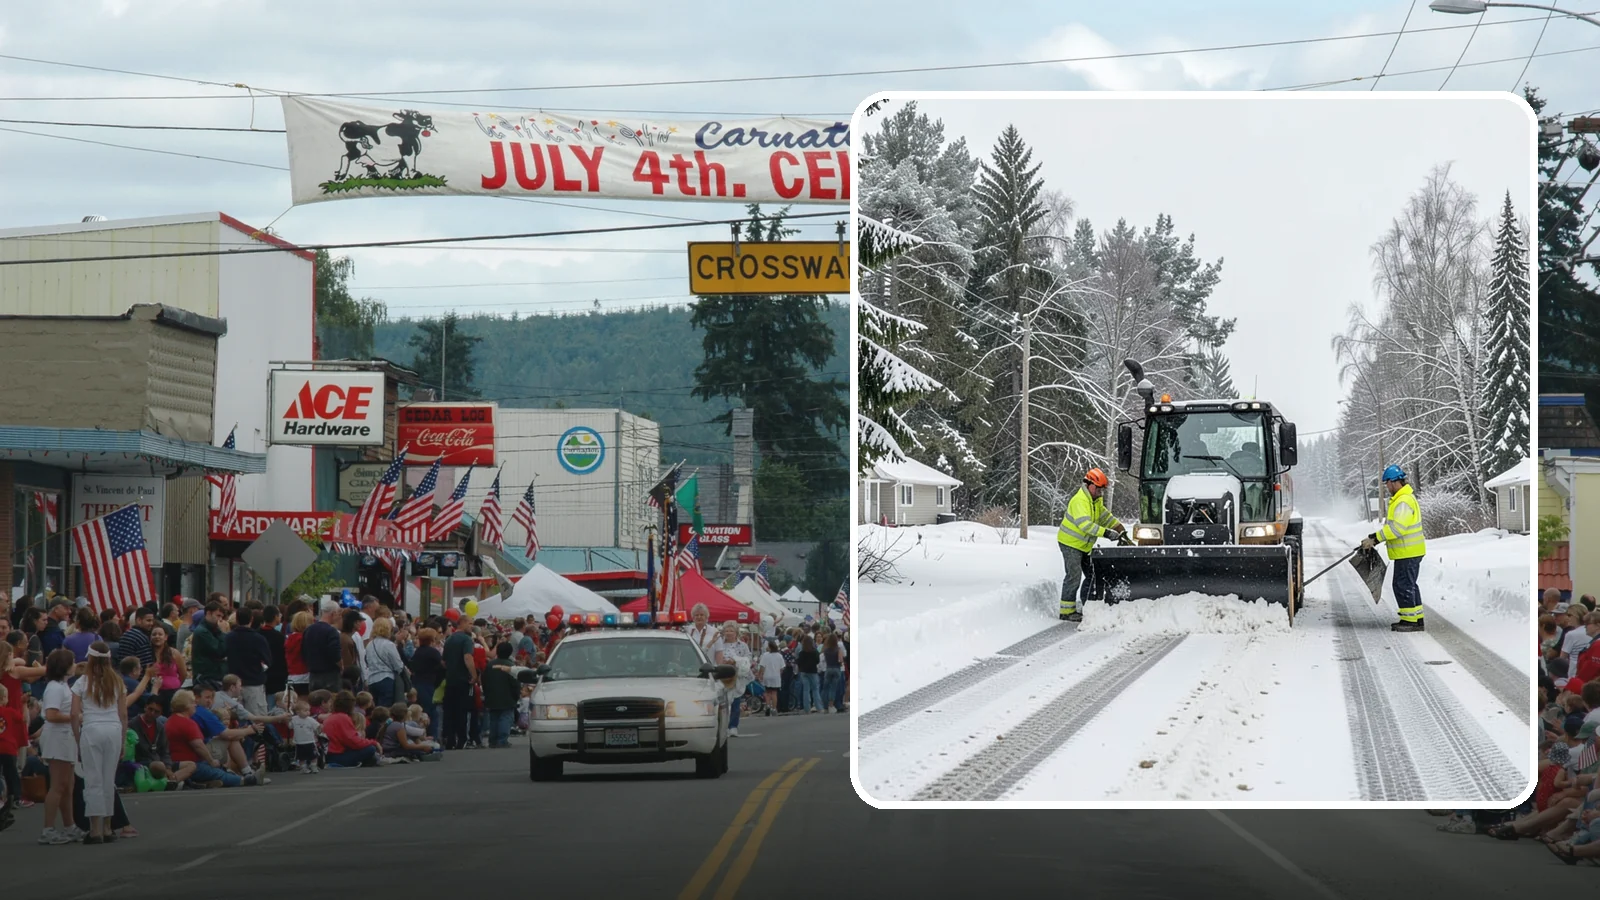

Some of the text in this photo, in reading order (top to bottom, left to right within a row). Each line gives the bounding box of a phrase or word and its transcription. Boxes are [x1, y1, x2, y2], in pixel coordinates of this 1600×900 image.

[481, 141, 605, 192] JULY
[632, 150, 747, 197] 4th.
[697, 254, 850, 280] CROSSWA
[283, 380, 373, 420] ACE
[406, 409, 485, 422] CEDAR LOG
[283, 421, 370, 436] Hardware
[416, 428, 476, 447] Coca-Cola
[83, 485, 155, 495] St. Vincent de Paul
[688, 526, 742, 535] CRNATION
[699, 535, 730, 543] GLASS
